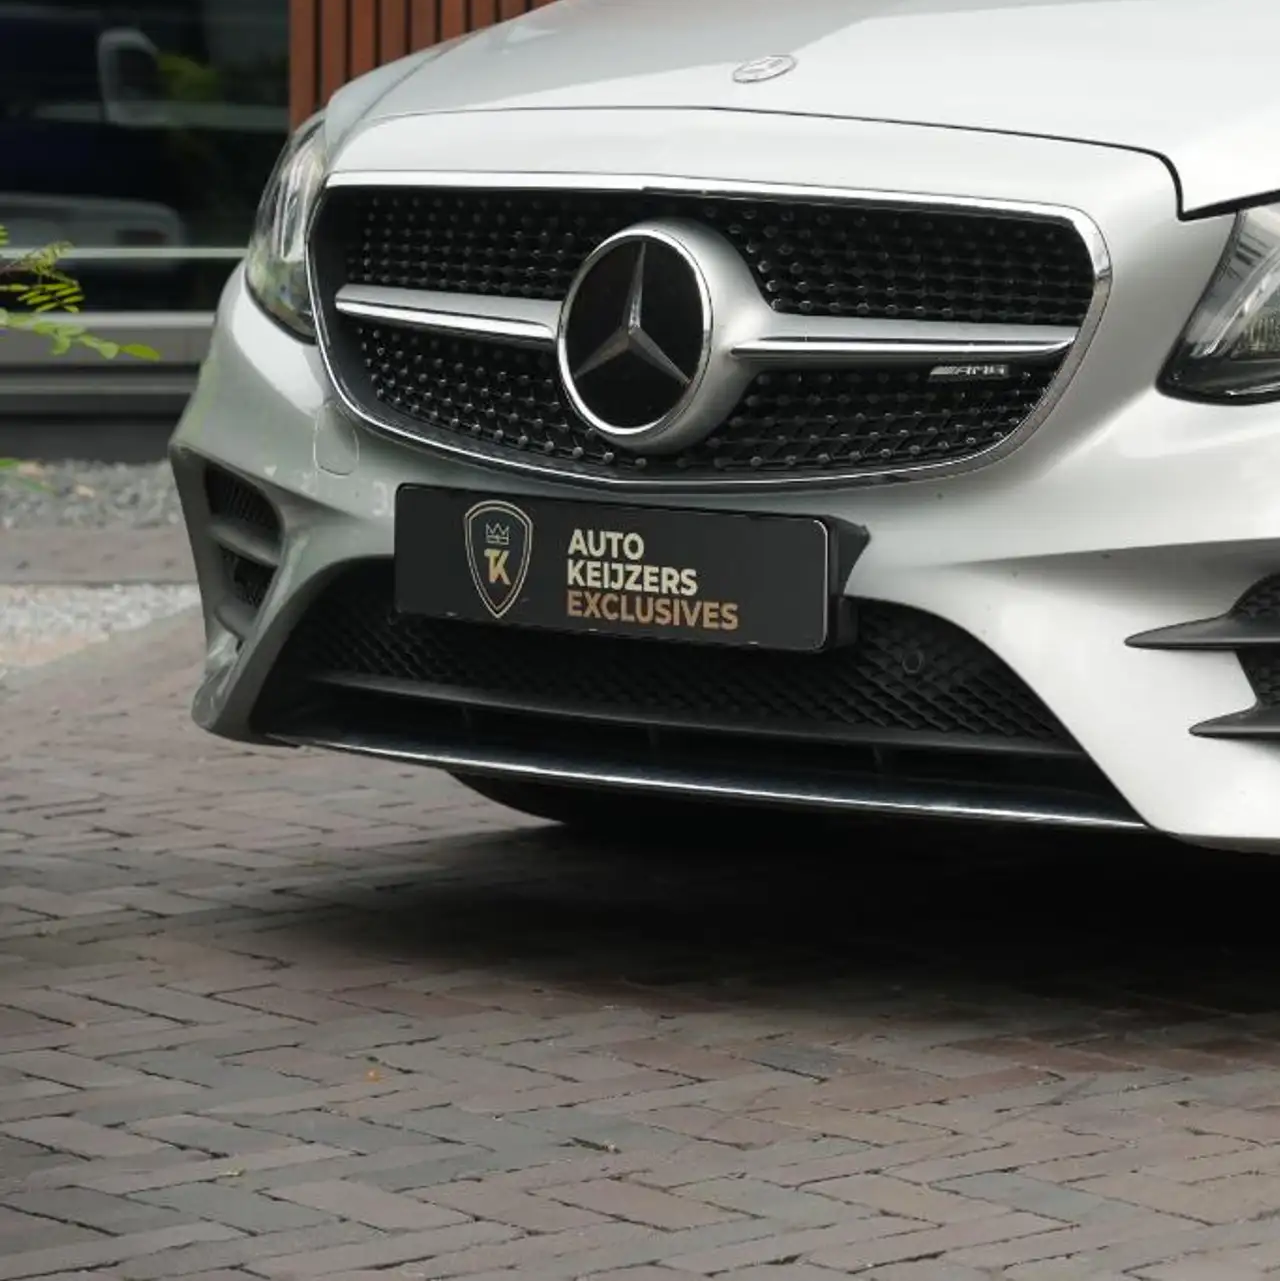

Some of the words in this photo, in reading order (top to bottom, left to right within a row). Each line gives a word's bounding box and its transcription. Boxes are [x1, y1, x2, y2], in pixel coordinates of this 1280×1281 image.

[567, 528, 645, 560] AUTO
[566, 558, 698, 597] KEIJZERS
[566, 589, 740, 631] EXCLUSIVES
